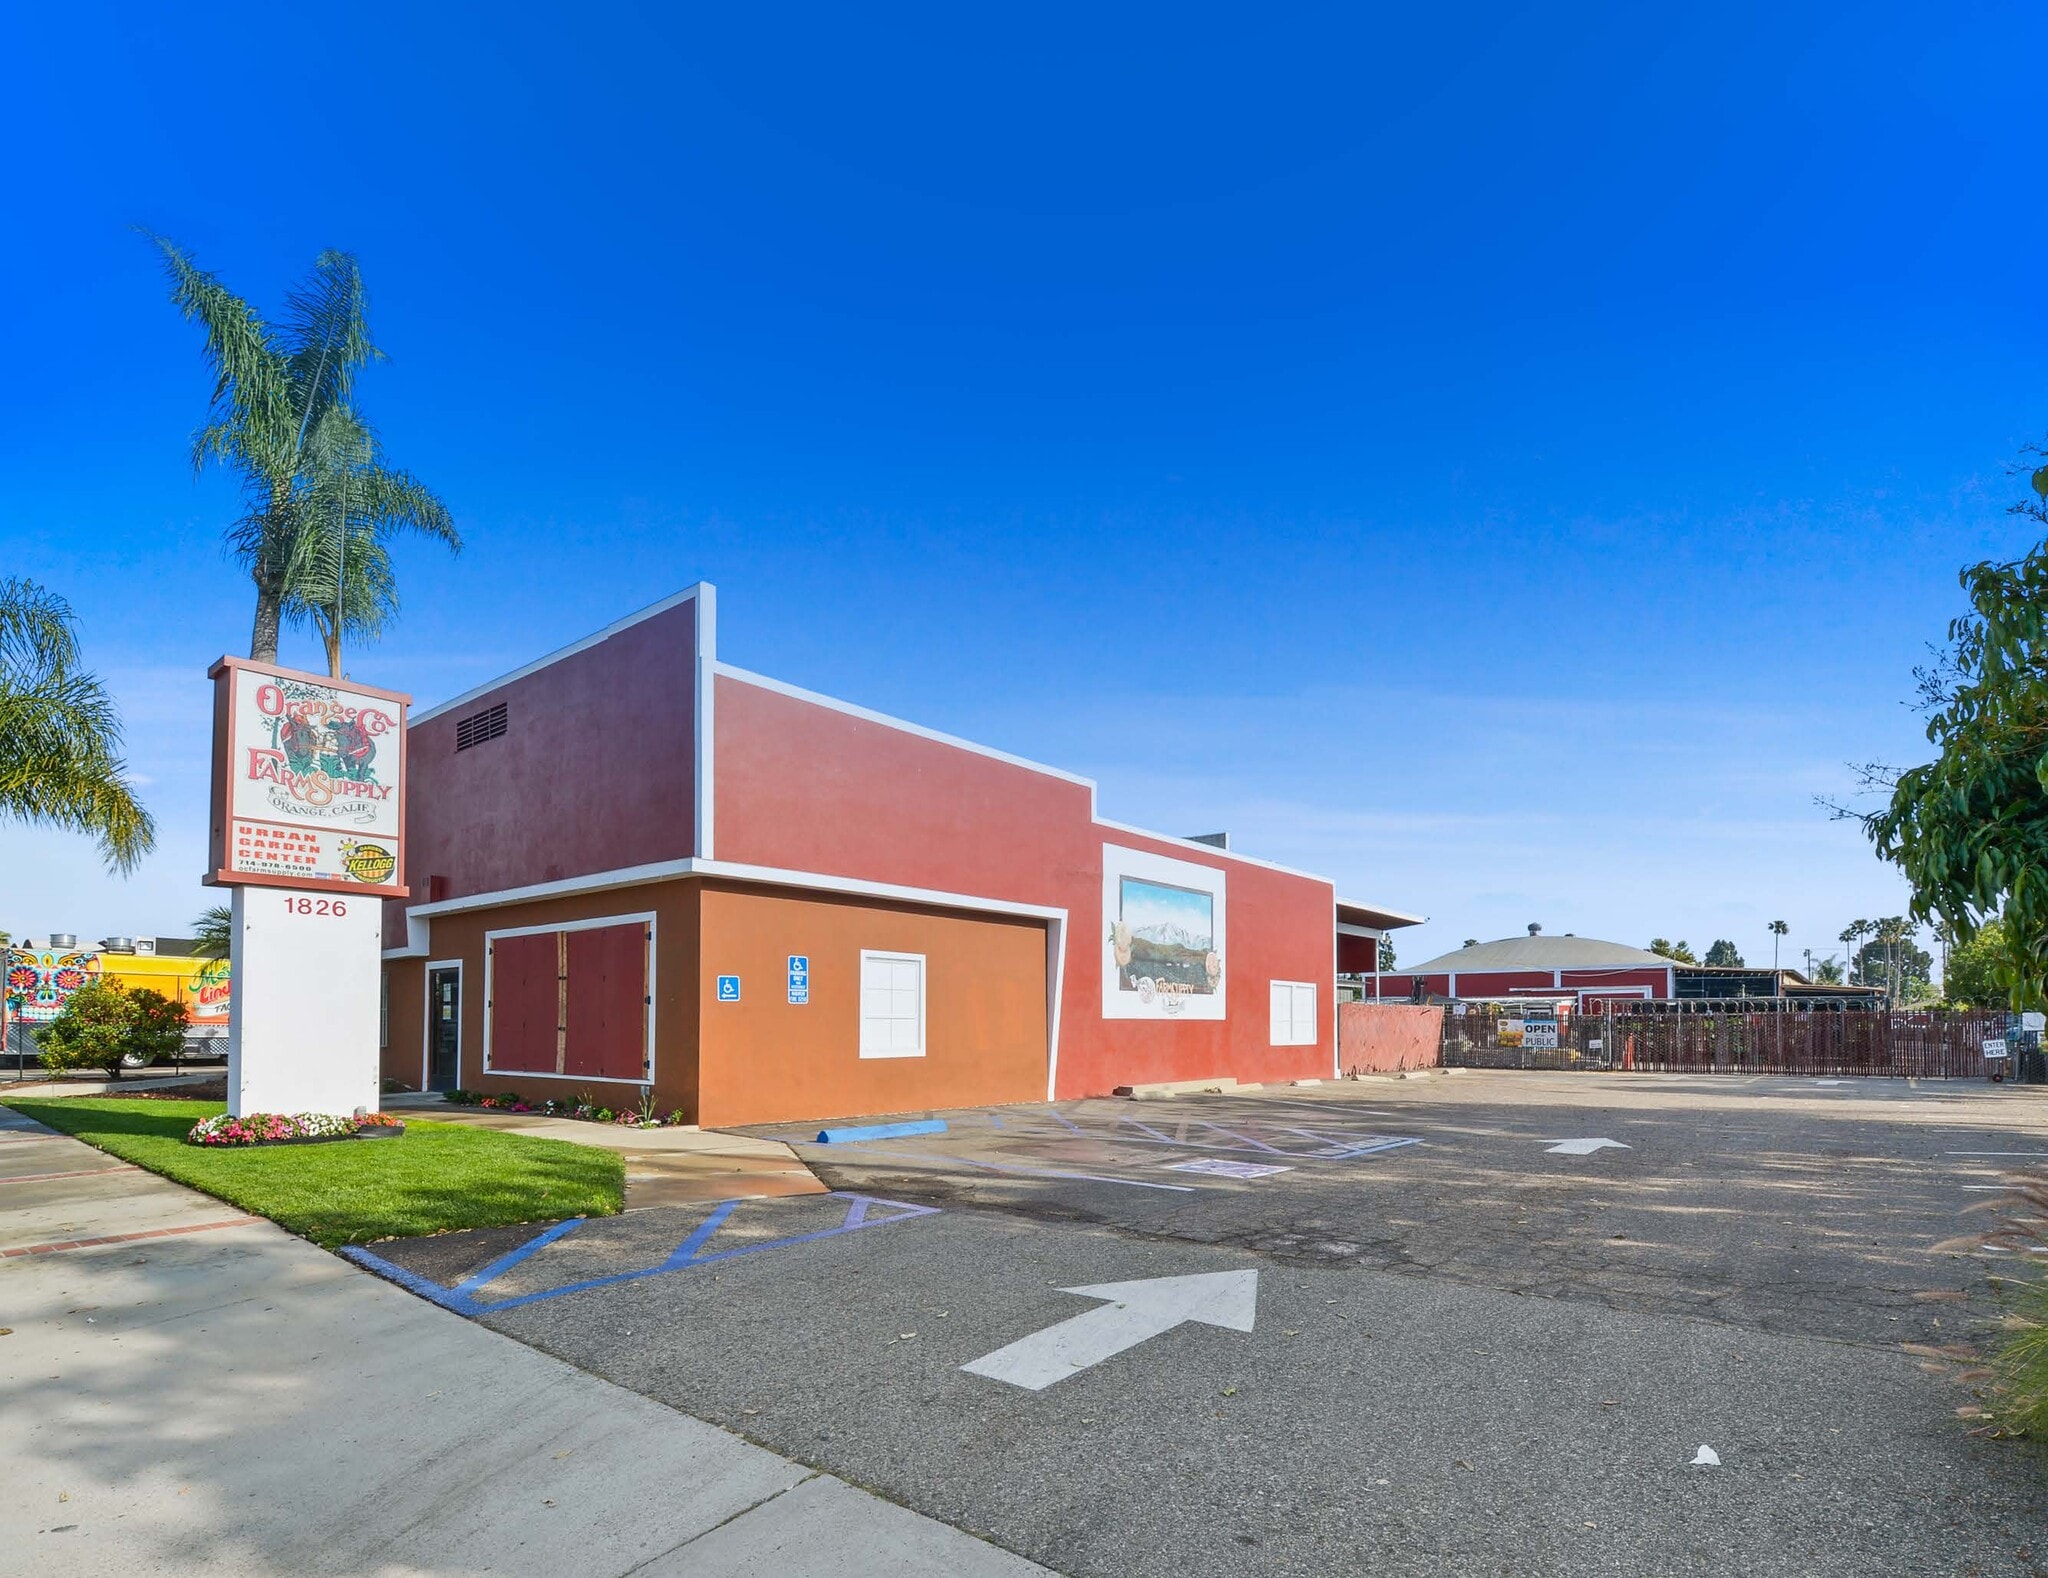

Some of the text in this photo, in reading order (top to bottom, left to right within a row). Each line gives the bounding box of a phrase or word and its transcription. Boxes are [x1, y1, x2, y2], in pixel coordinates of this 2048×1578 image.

[256, 684, 358, 726] Orange
[239, 826, 316, 843] URBAN
[239, 838, 320, 854] GARDEN
[238, 849, 316, 865] CENTER
[238, 866, 313, 878] ocfarmsupply.com
[348, 858, 394, 872] KELLOGG
[284, 897, 347, 917] 1826
[1525, 1024, 1556, 1034] OPEN
[1525, 1037, 1555, 1047] PUBLIC
[1984, 1041, 2005, 1049] ENTER
